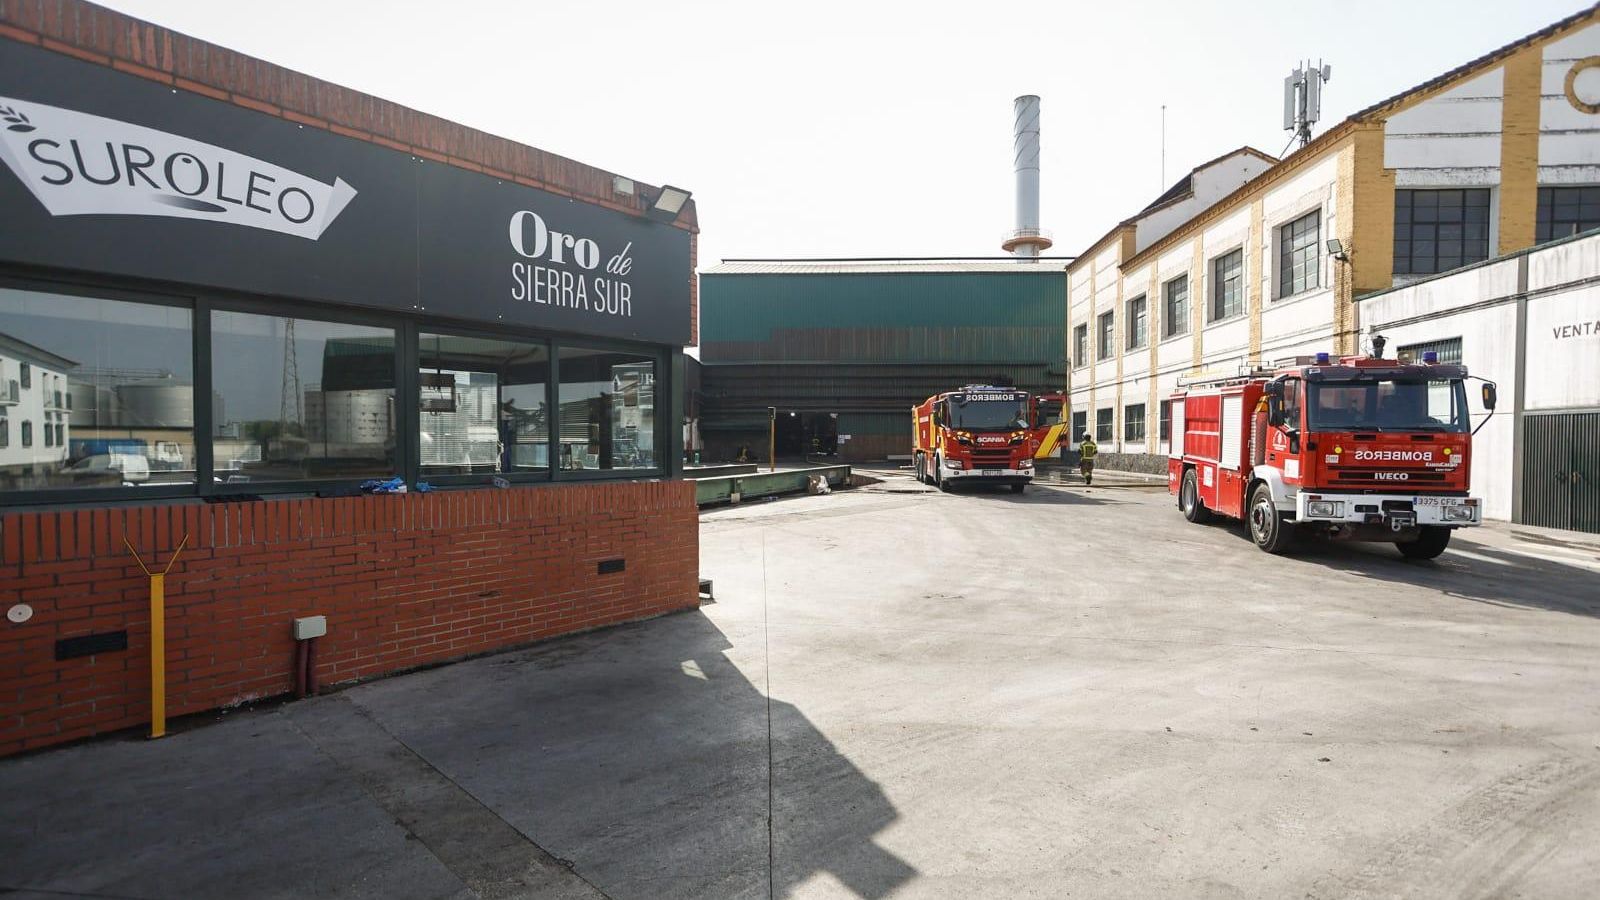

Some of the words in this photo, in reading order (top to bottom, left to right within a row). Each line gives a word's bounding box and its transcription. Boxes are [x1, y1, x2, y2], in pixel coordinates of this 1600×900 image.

[27, 138, 315, 224] SUROLEO
[509, 210, 600, 270] Oro
[606, 241, 632, 276] de
[511, 262, 588, 310] SIERRA
[594, 277, 631, 316] SUR
[1374, 472, 1409, 480] IVECO
[1418, 498, 1439, 506] 3375
[1440, 498, 1457, 506] CFG
